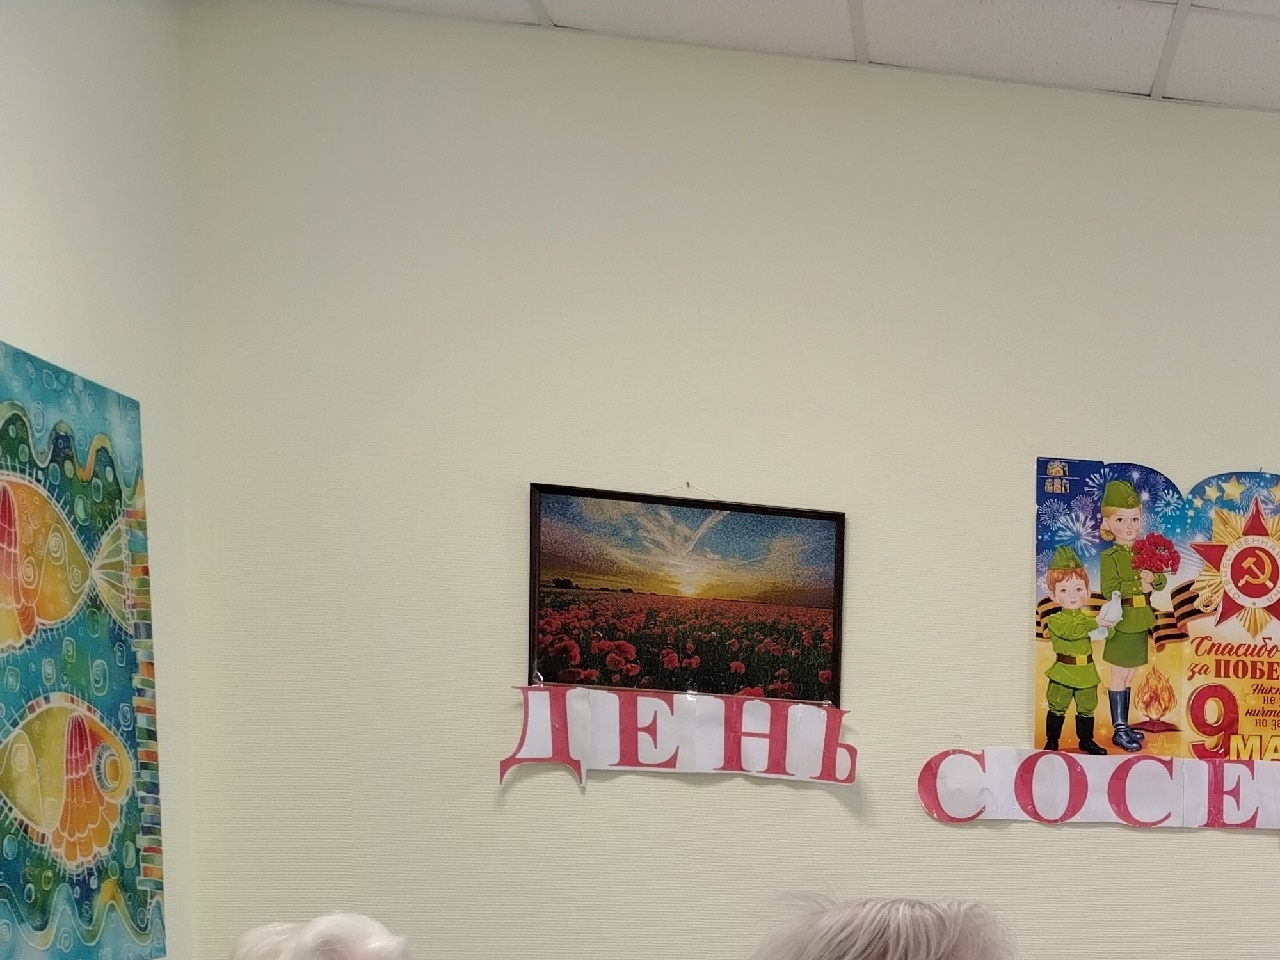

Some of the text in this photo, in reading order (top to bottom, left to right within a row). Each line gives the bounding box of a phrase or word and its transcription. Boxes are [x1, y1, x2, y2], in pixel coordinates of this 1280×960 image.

[1187, 661, 1211, 681] за
[1262, 695, 1276, 705] не
[1187, 682, 1240, 760] 9
[1255, 719, 1268, 728] не
[499, 684, 858, 786] ДЕНЬ
